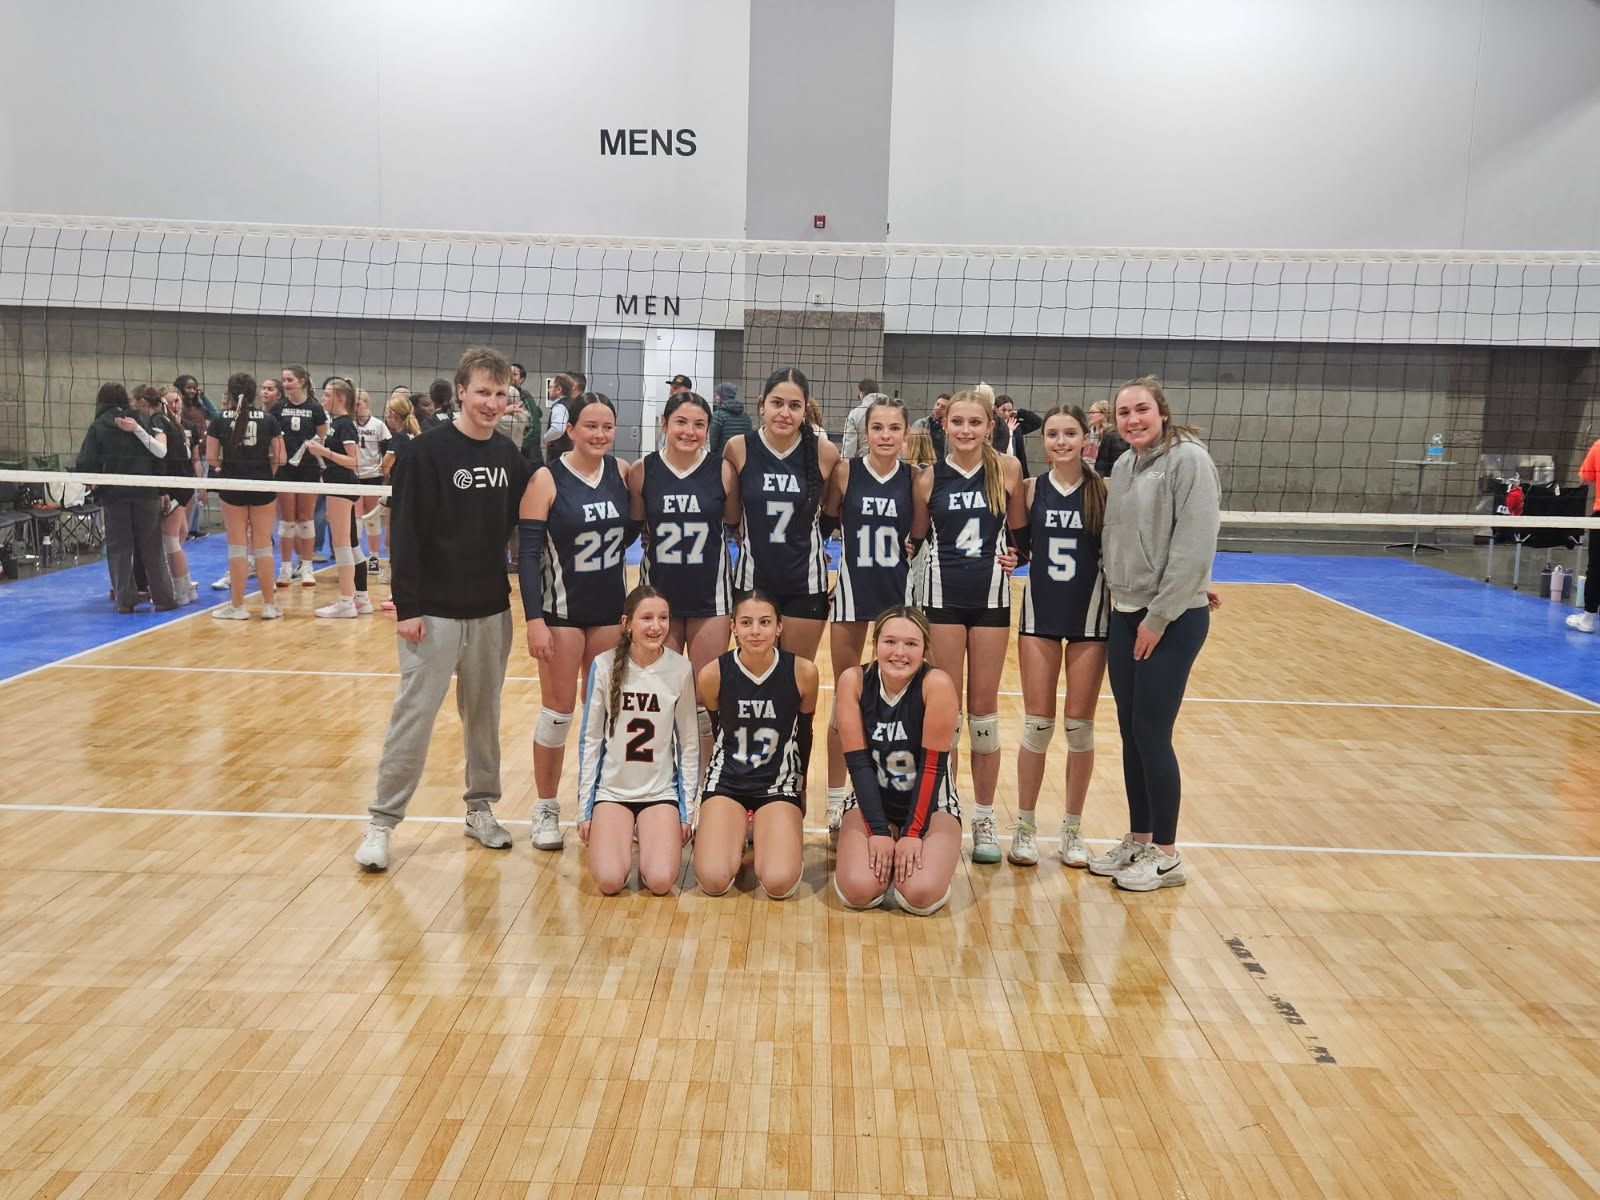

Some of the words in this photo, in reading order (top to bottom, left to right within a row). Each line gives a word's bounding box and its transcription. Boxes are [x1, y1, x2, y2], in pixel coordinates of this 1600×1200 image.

[600, 129, 697, 156] MENS
[616, 294, 680, 316] MEN
[473, 467, 509, 488] EVA
[763, 473, 801, 493] EVA
[582, 500, 620, 523] EVA
[663, 494, 702, 514] EVA
[861, 496, 898, 518] EVA
[948, 491, 987, 511] EVA
[766, 500, 795, 543] 7
[1045, 509, 1083, 529] EVA
[574, 526, 625, 572] 22
[656, 521, 710, 564] 27
[856, 524, 901, 568] 10
[955, 517, 984, 558] 4
[1047, 537, 1078, 582] 5
[622, 692, 661, 713] EVA
[738, 699, 777, 719] EVA
[625, 717, 656, 763] 2
[871, 720, 908, 742] EVA
[731, 726, 780, 769] 13
[871, 749, 917, 791] 19
